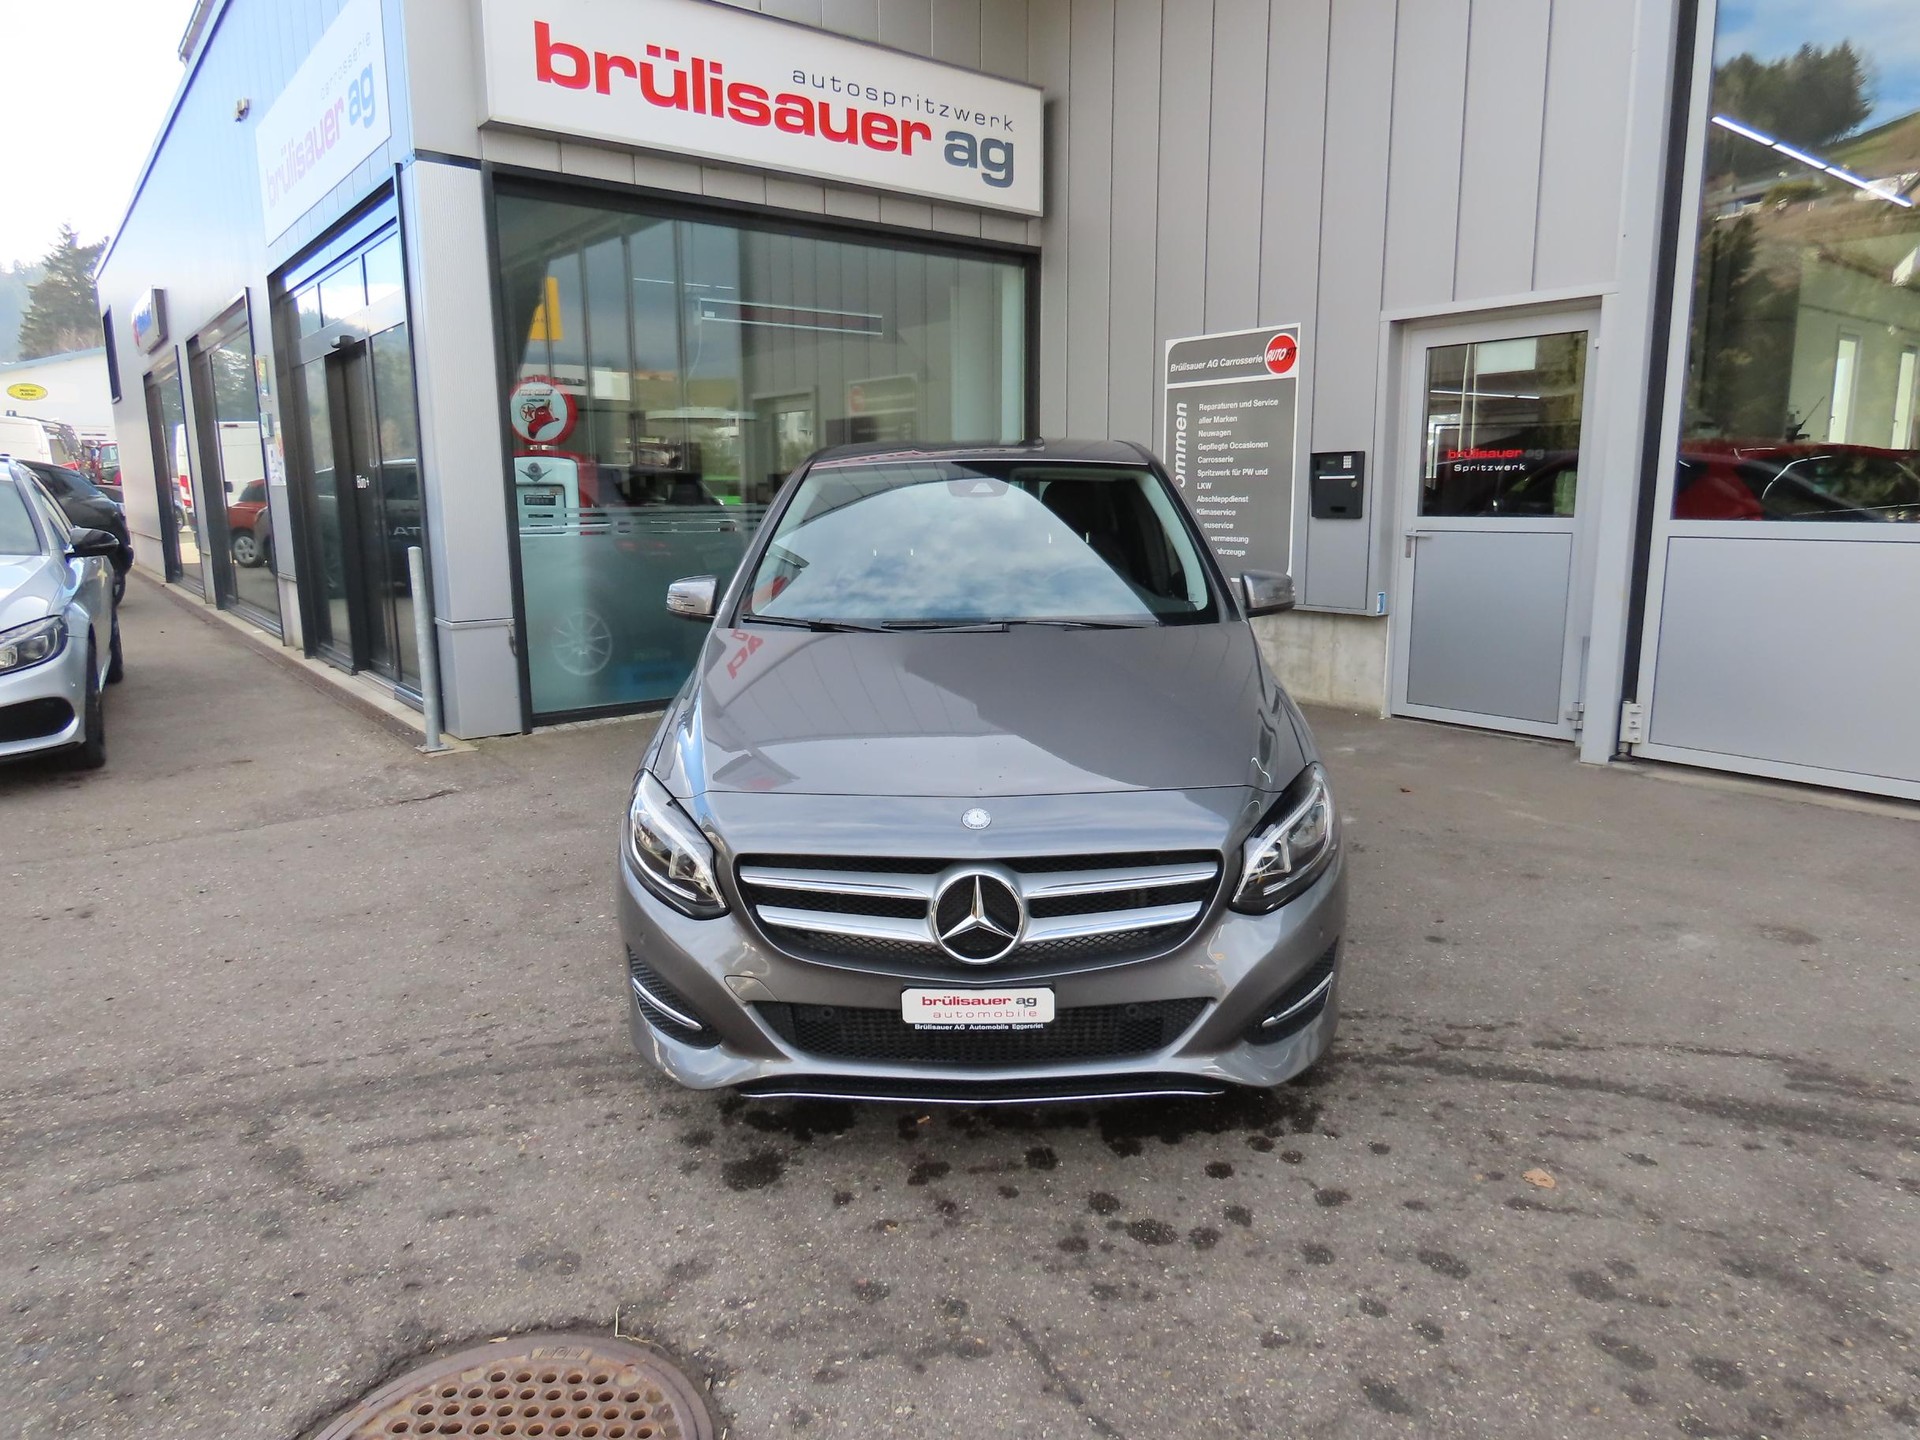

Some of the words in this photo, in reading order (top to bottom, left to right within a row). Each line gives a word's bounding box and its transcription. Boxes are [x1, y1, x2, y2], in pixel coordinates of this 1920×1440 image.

[534, 20, 932, 156] brülisauer
[944, 130, 1015, 188] ag
[792, 69, 1014, 132] autospritzwerk
[266, 96, 345, 208] brülisauer
[348, 62, 376, 129] ag
[1170, 362, 1206, 373] Brülisauer
[1207, 359, 1219, 369] AG
[1220, 354, 1263, 367] Carrosserie
[1199, 402, 1238, 412] Reparaturen
[1239, 400, 1252, 409] und
[1253, 398, 1279, 408] Service
[1198, 417, 1212, 425] aller
[1213, 415, 1238, 424] Marken
[1198, 430, 1231, 438] Neuwagen
[1198, 442, 1228, 451] Gepflegte
[1229, 441, 1269, 449] Occasionen
[1448, 448, 1523, 459] brülisauer
[1524, 449, 1545, 460] ag
[1197, 455, 1234, 464] Carrosserie
[1197, 469, 1230, 478] Spritzwerk
[1231, 468, 1242, 476] für
[1242, 468, 1254, 476] PW
[1254, 467, 1269, 476] und
[1454, 464, 1526, 472] Spritzwerk
[1197, 482, 1212, 490] LKW
[1196, 495, 1249, 504] Abschleppdienst
[1204, 521, 1234, 530] euservice
[1210, 535, 1250, 544] vermessung
[922, 996, 1011, 1006] brülisauer
[1015, 997, 1037, 1008] ag
[933, 1010, 1038, 1019] automobile
[914, 1023, 953, 1031] Brülisauer
[954, 1023, 966, 1031] AG
[969, 1023, 1009, 1031] Automobile
